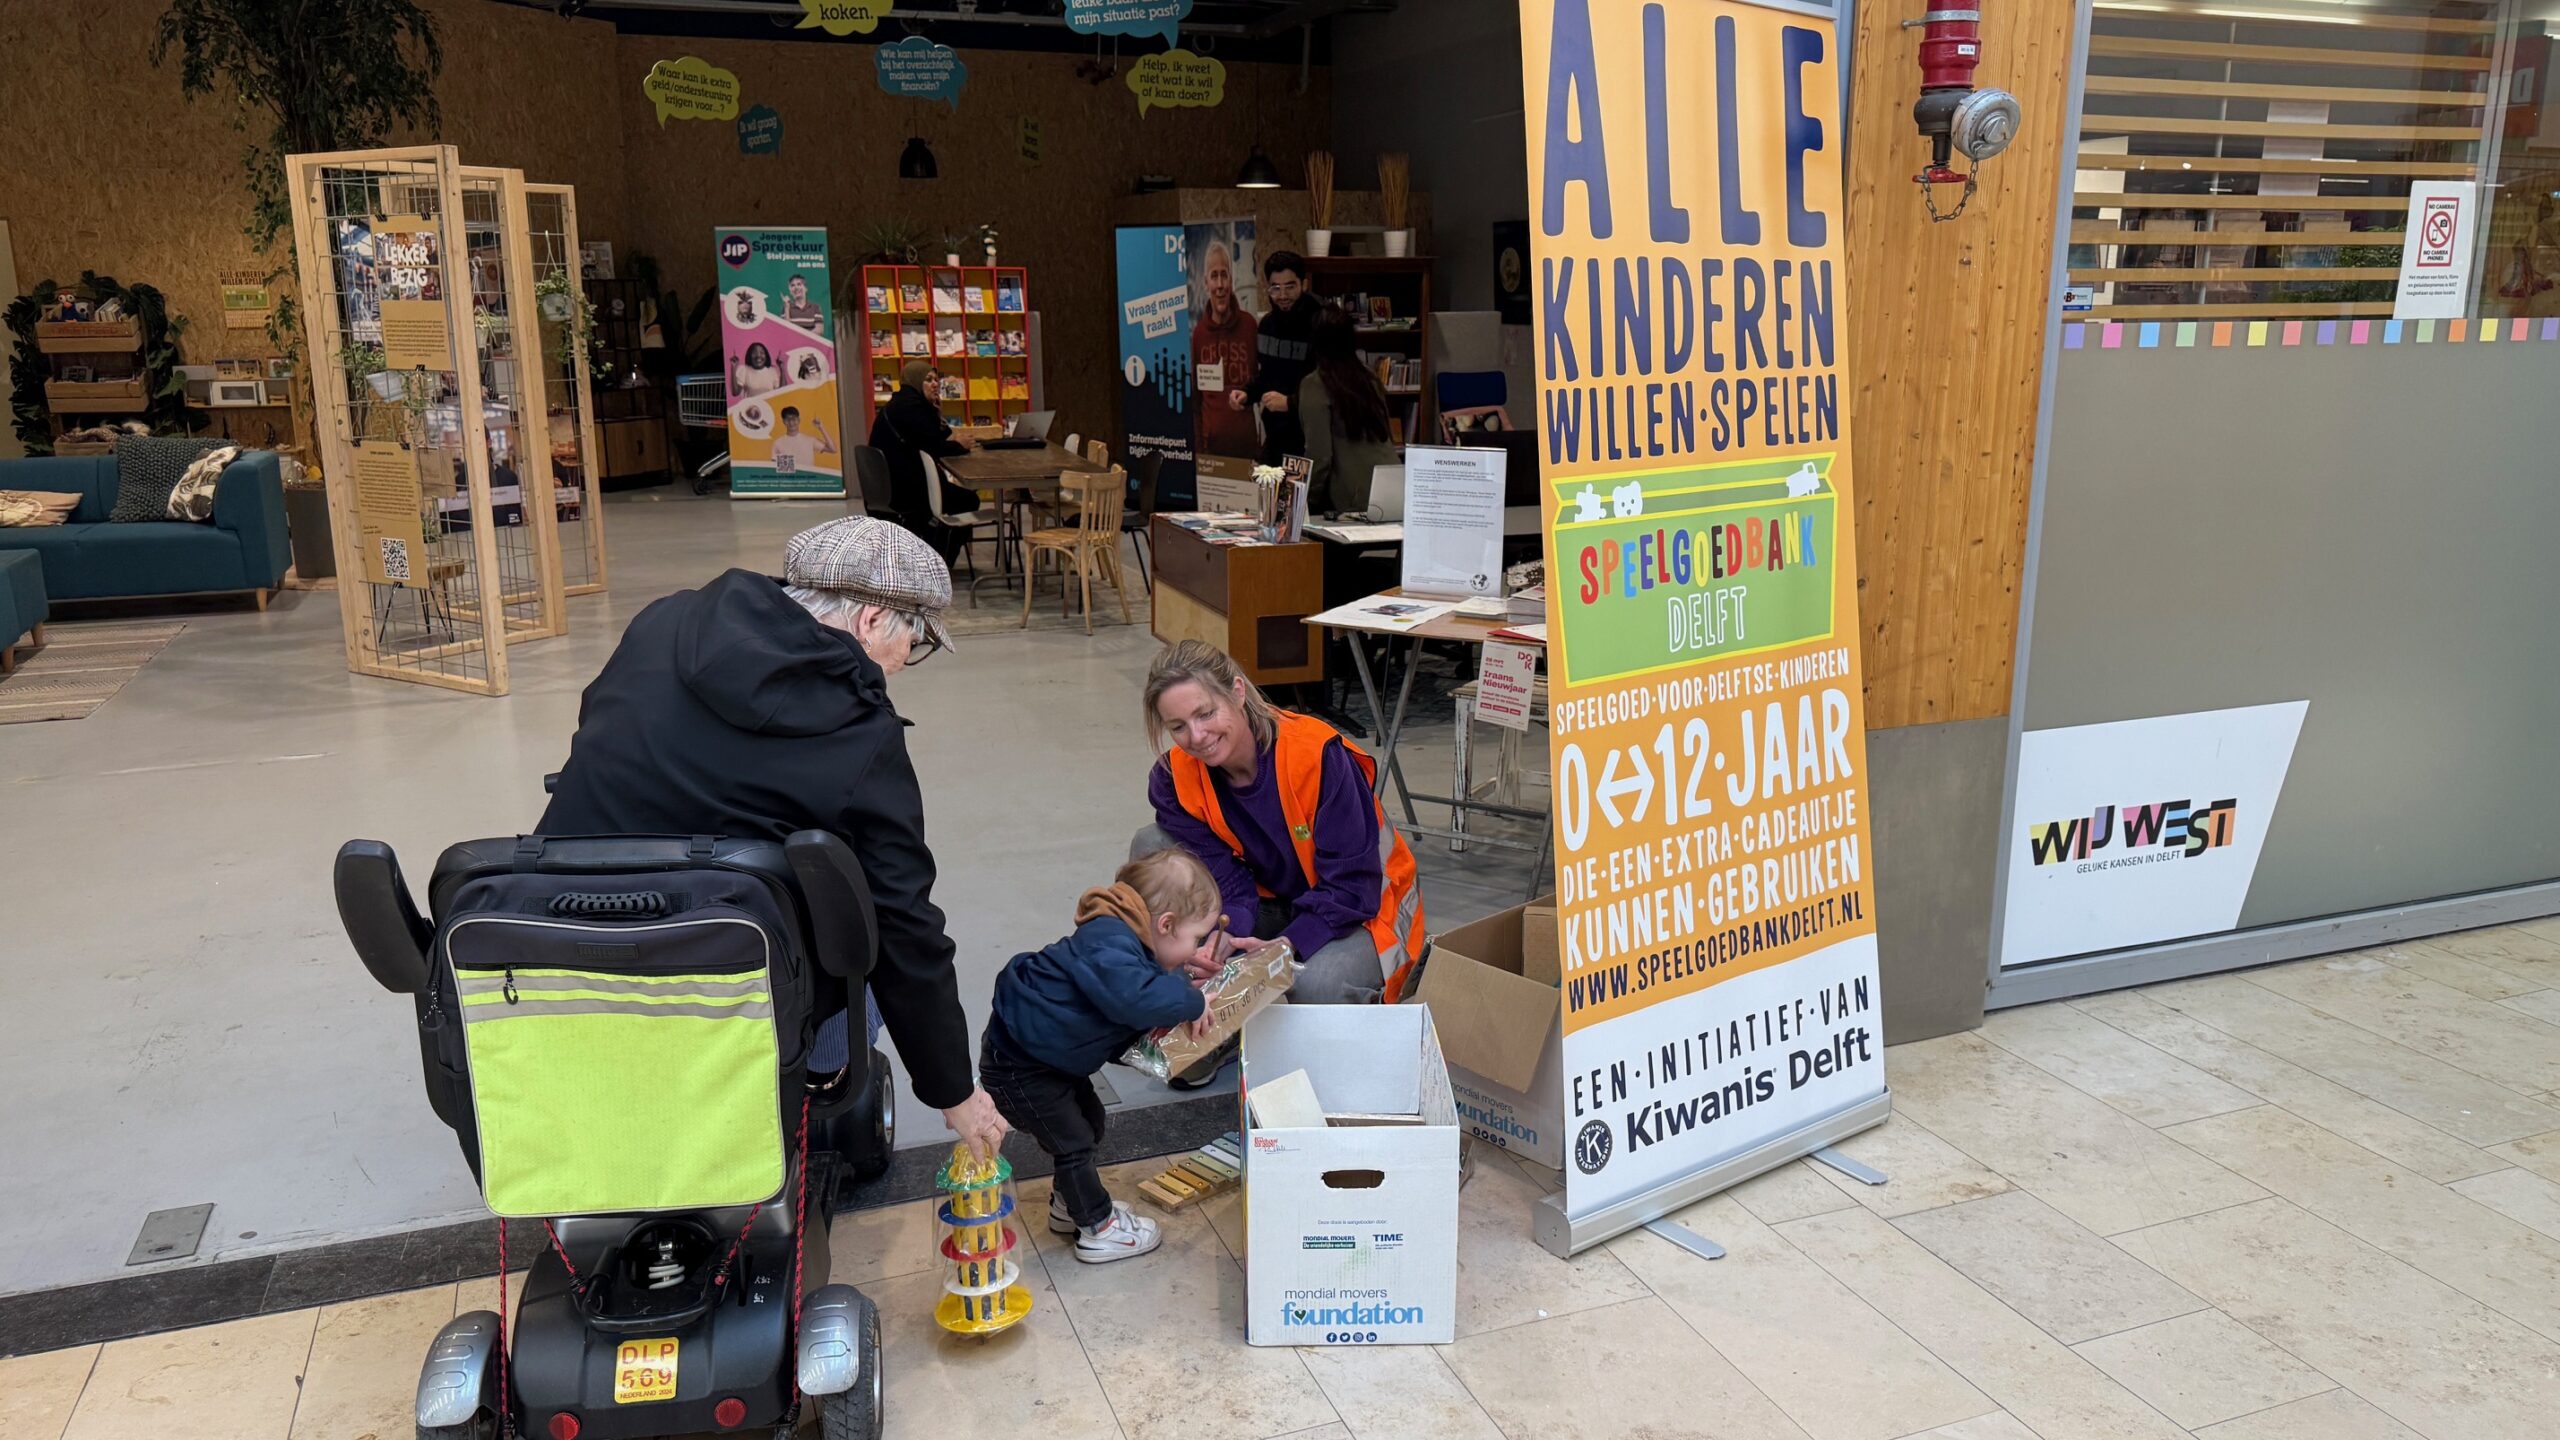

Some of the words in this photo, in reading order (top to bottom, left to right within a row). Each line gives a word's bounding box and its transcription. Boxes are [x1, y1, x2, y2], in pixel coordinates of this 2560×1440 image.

[819, 4, 874, 20] koken.
[1074, 13, 1101, 26] mijn
[1104, 8, 1146, 22] situatie
[1149, 4, 1180, 20] past?
[927, 49, 953, 61] helpen
[1143, 59, 1170, 72] Help,
[1173, 60, 1183, 71] ik
[1186, 62, 1211, 74] weet
[658, 66, 680, 79] Waar
[683, 71, 698, 83] kan
[700, 74, 708, 84] ik
[710, 78, 732, 89] extra
[917, 71, 931, 80] van
[1140, 74, 1160, 85] niet
[1162, 75, 1182, 86] wat
[1185, 75, 1194, 86] ik
[1197, 76, 1213, 88] wil
[665, 93, 693, 108] krijgen
[1142, 86, 1153, 97] of
[1155, 87, 1175, 98] kan
[1179, 90, 1210, 101] doen?
[1542, 0, 1827, 247] ALLE
[759, 233, 803, 242] Jongeren
[385, 243, 430, 266] LEKKER
[723, 243, 748, 257] JIP
[751, 241, 824, 254] Spreekuur
[390, 267, 428, 288] BEZIG
[1128, 301, 1158, 319] Vraag
[1159, 294, 1185, 311] maar
[1146, 316, 1173, 333] raak!
[1542, 256, 1834, 382] KINDEREN
[1128, 433, 1187, 448] Informatiepunt
[1159, 448, 1193, 461] verheid
[1434, 459, 1476, 467] WENSWERKEN
[1580, 511, 1817, 605] SPEELGOEDBANK
[1668, 586, 1747, 653] DELFT
[1484, 670, 1514, 682] Iraans
[1482, 679, 1527, 694] Nieuwjaar
[2029, 805, 2115, 866] WIJ
[2122, 798, 2237, 858] WEST
[2076, 860, 2108, 874] GELIJKE
[2109, 855, 2144, 869] KANSEN
[2145, 854, 2154, 863] IN
[2156, 850, 2181, 863] DELFT
[1568, 891, 1863, 1013] WWW.SPEELGOEDBANKDELFT.NL
[1626, 1066, 1774, 1154] Kiwanis
[1789, 1027, 1871, 1091] Delft
[1481, 1095, 1513, 1113] movers
[1455, 1100, 1538, 1146] undation
[1580, 1125, 1605, 1141] KIWANIS
[1372, 1233, 1404, 1242] TIME
[1284, 1288, 1335, 1299] mondial
[1340, 1289, 1388, 1299] movers
[1280, 1301, 1424, 1326] foundation
[622, 1343, 675, 1364] DLP
[622, 1367, 672, 1388] 569
[620, 1390, 656, 1399] NEDERLAND
